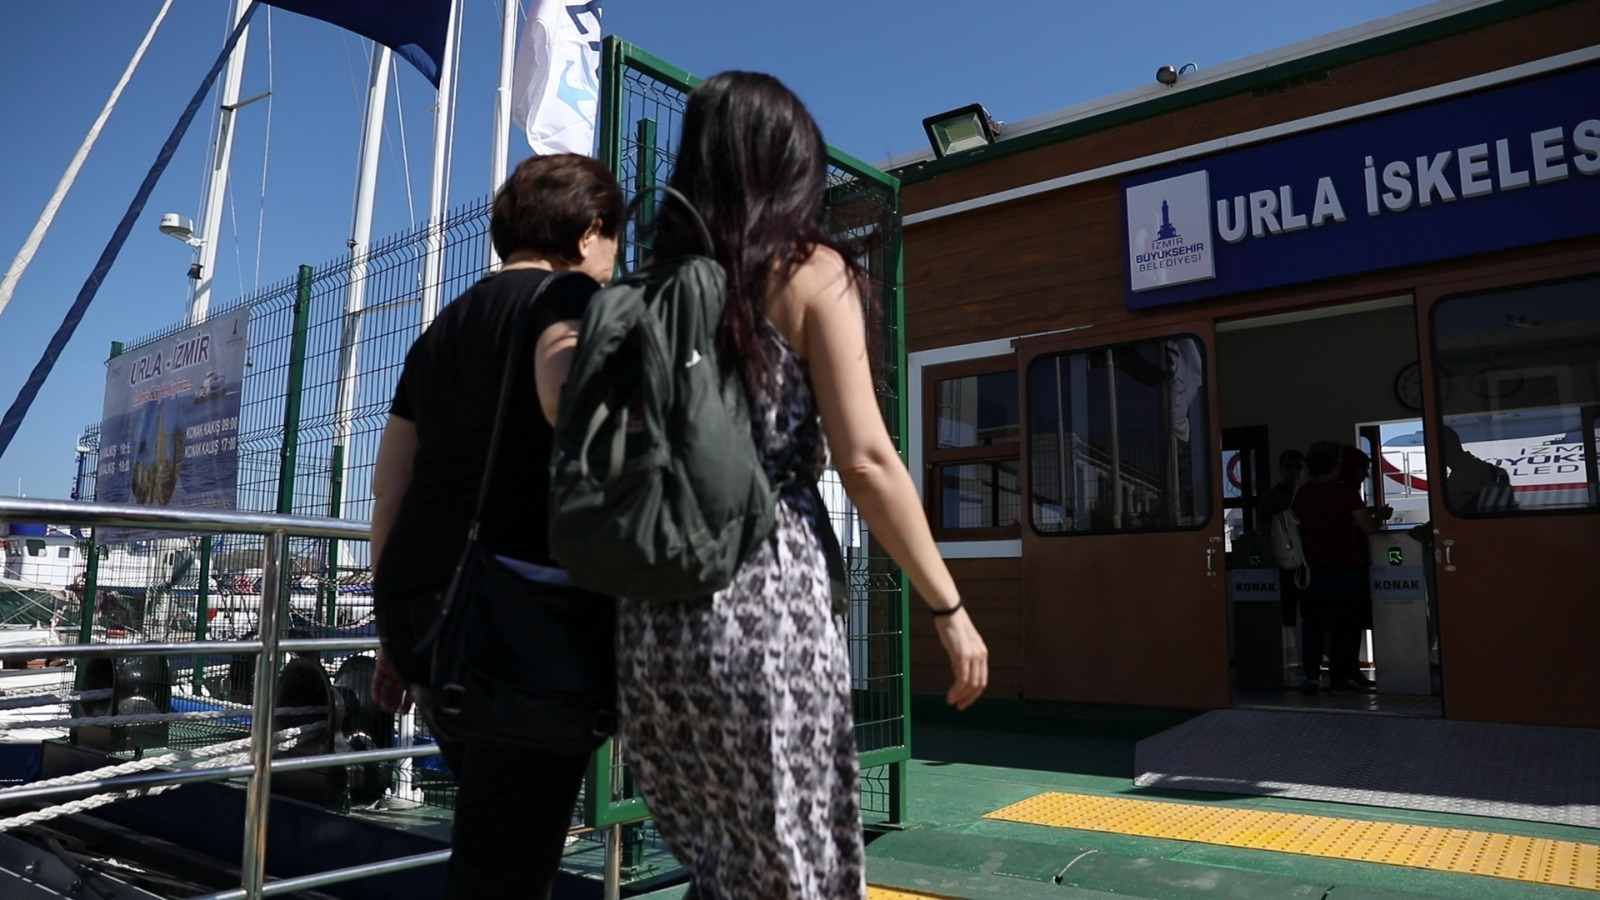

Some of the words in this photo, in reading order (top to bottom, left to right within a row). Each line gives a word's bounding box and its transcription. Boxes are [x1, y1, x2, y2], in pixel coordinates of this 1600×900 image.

[1217, 176, 1347, 243] URLA
[1152, 237, 1183, 250] İZMİR
[1136, 243, 1204, 263] BÜYÜKŞEHİR
[1139, 253, 1202, 272] BELEDİYESİ
[130, 352, 162, 385] URLA
[173, 332, 209, 371] İZMİR
[185, 424, 203, 439] KONAK
[184, 443, 202, 458] KONAK
[1236, 582, 1276, 593] KONAK
[1374, 579, 1420, 591] KONAK
